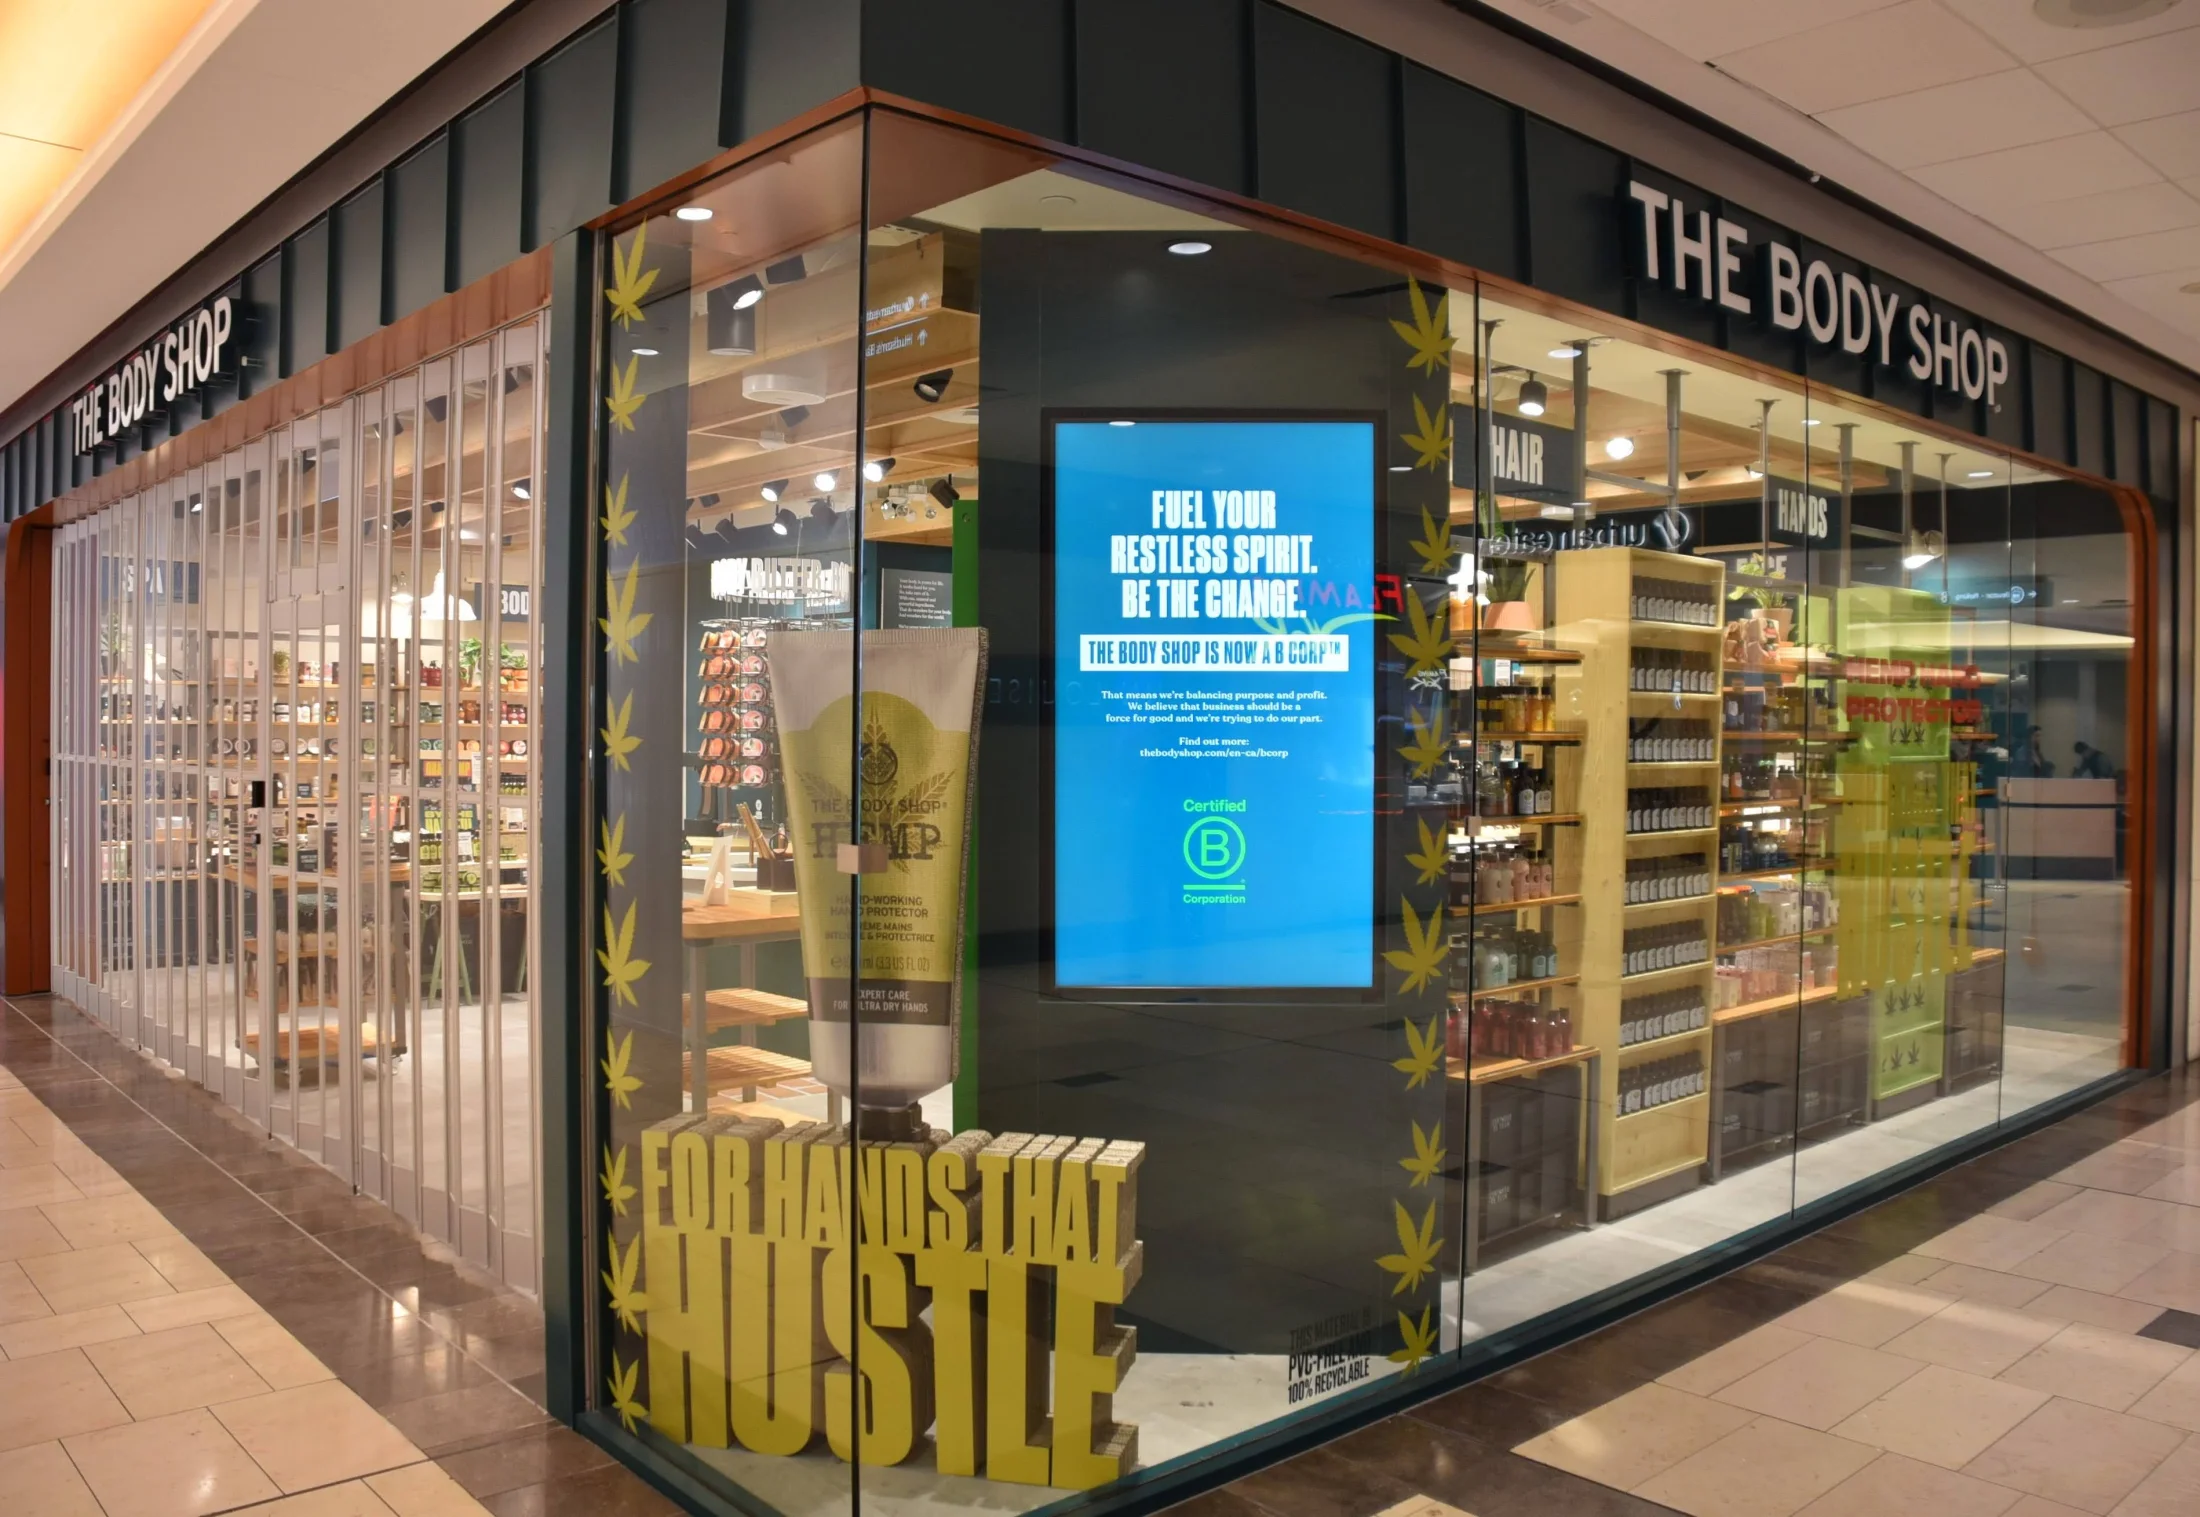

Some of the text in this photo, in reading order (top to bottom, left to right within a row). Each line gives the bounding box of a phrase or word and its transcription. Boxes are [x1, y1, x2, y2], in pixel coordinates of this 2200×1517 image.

[1629, 180, 2009, 406] THE BODY SHOP
[72, 295, 232, 457] THE BODY SHOP
[1491, 425, 1544, 486] HAIR
[1152, 490, 1276, 529] FUEL YOUR
[1778, 488, 1828, 539] HANDS
[1110, 535, 1318, 574] RESTLESS SPIRIT.
[751, 557, 823, 598] BUTTER
[500, 591, 530, 615] BOD
[1122, 579, 1307, 619] BE THE CHANGE.
[1088, 640, 1114, 665] THE
[1118, 640, 1157, 665] BODY
[1161, 640, 1200, 665] SHOP
[1204, 640, 1219, 665] IS
[1223, 640, 1258, 665] NOW
[1262, 640, 1271, 665] A
[1274, 640, 1284, 665] B
[1101, 690, 1328, 702] That means we're balancing purpose and profit.
[1128, 702, 1302, 711] We believe that business should be a
[1105, 714, 1323, 724] force for good and we're trying to do our part.
[1846, 696, 1982, 724] PROTECTOR
[1139, 748, 1289, 758] thebodyshop.com/en-ca/bcorp
[1178, 736, 1250, 746] Find out more:
[811, 799, 841, 813] THE
[1183, 799, 1247, 813] Certified
[1201, 829, 1230, 867] B
[836, 895, 923, 906] HAD-WORKING
[1183, 894, 1246, 905] Corporation
[866, 906, 929, 918] PROTECTOR
[867, 932, 874, 940] &
[875, 932, 936, 943] PROTECTRICE
[883, 922, 913, 932] MAINS
[834, 1000, 849, 1011] FOR
[883, 1002, 901, 1012] DRY
[902, 1003, 929, 1013] HANDS
[858, 989, 911, 1000] XPERT CARE
[641, 1129, 1132, 1268] FOR HANDS THAT
[645, 1232, 1132, 1491] HUSTLE
[1289, 1343, 1346, 1382] PVC-FREE
[1288, 1357, 1370, 1405] 100% RECYCLABLE
